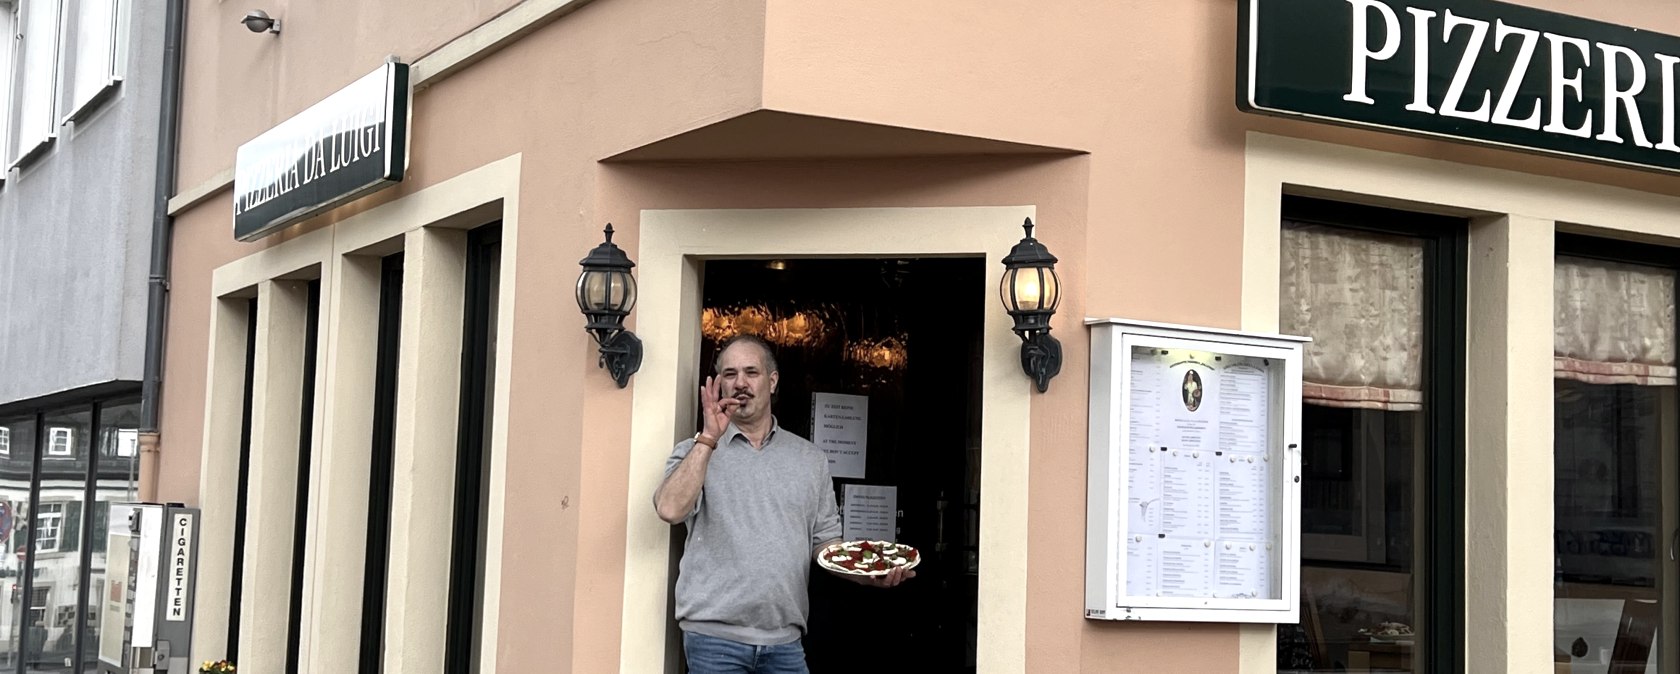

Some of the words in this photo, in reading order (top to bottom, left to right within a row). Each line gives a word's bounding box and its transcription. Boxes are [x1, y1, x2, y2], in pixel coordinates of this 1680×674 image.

[1343, 0, 1680, 153] PIZZERI
[303, 129, 327, 185] DA
[330, 103, 380, 173] LUIGI
[173, 518, 187, 616] CIGARETTEN
